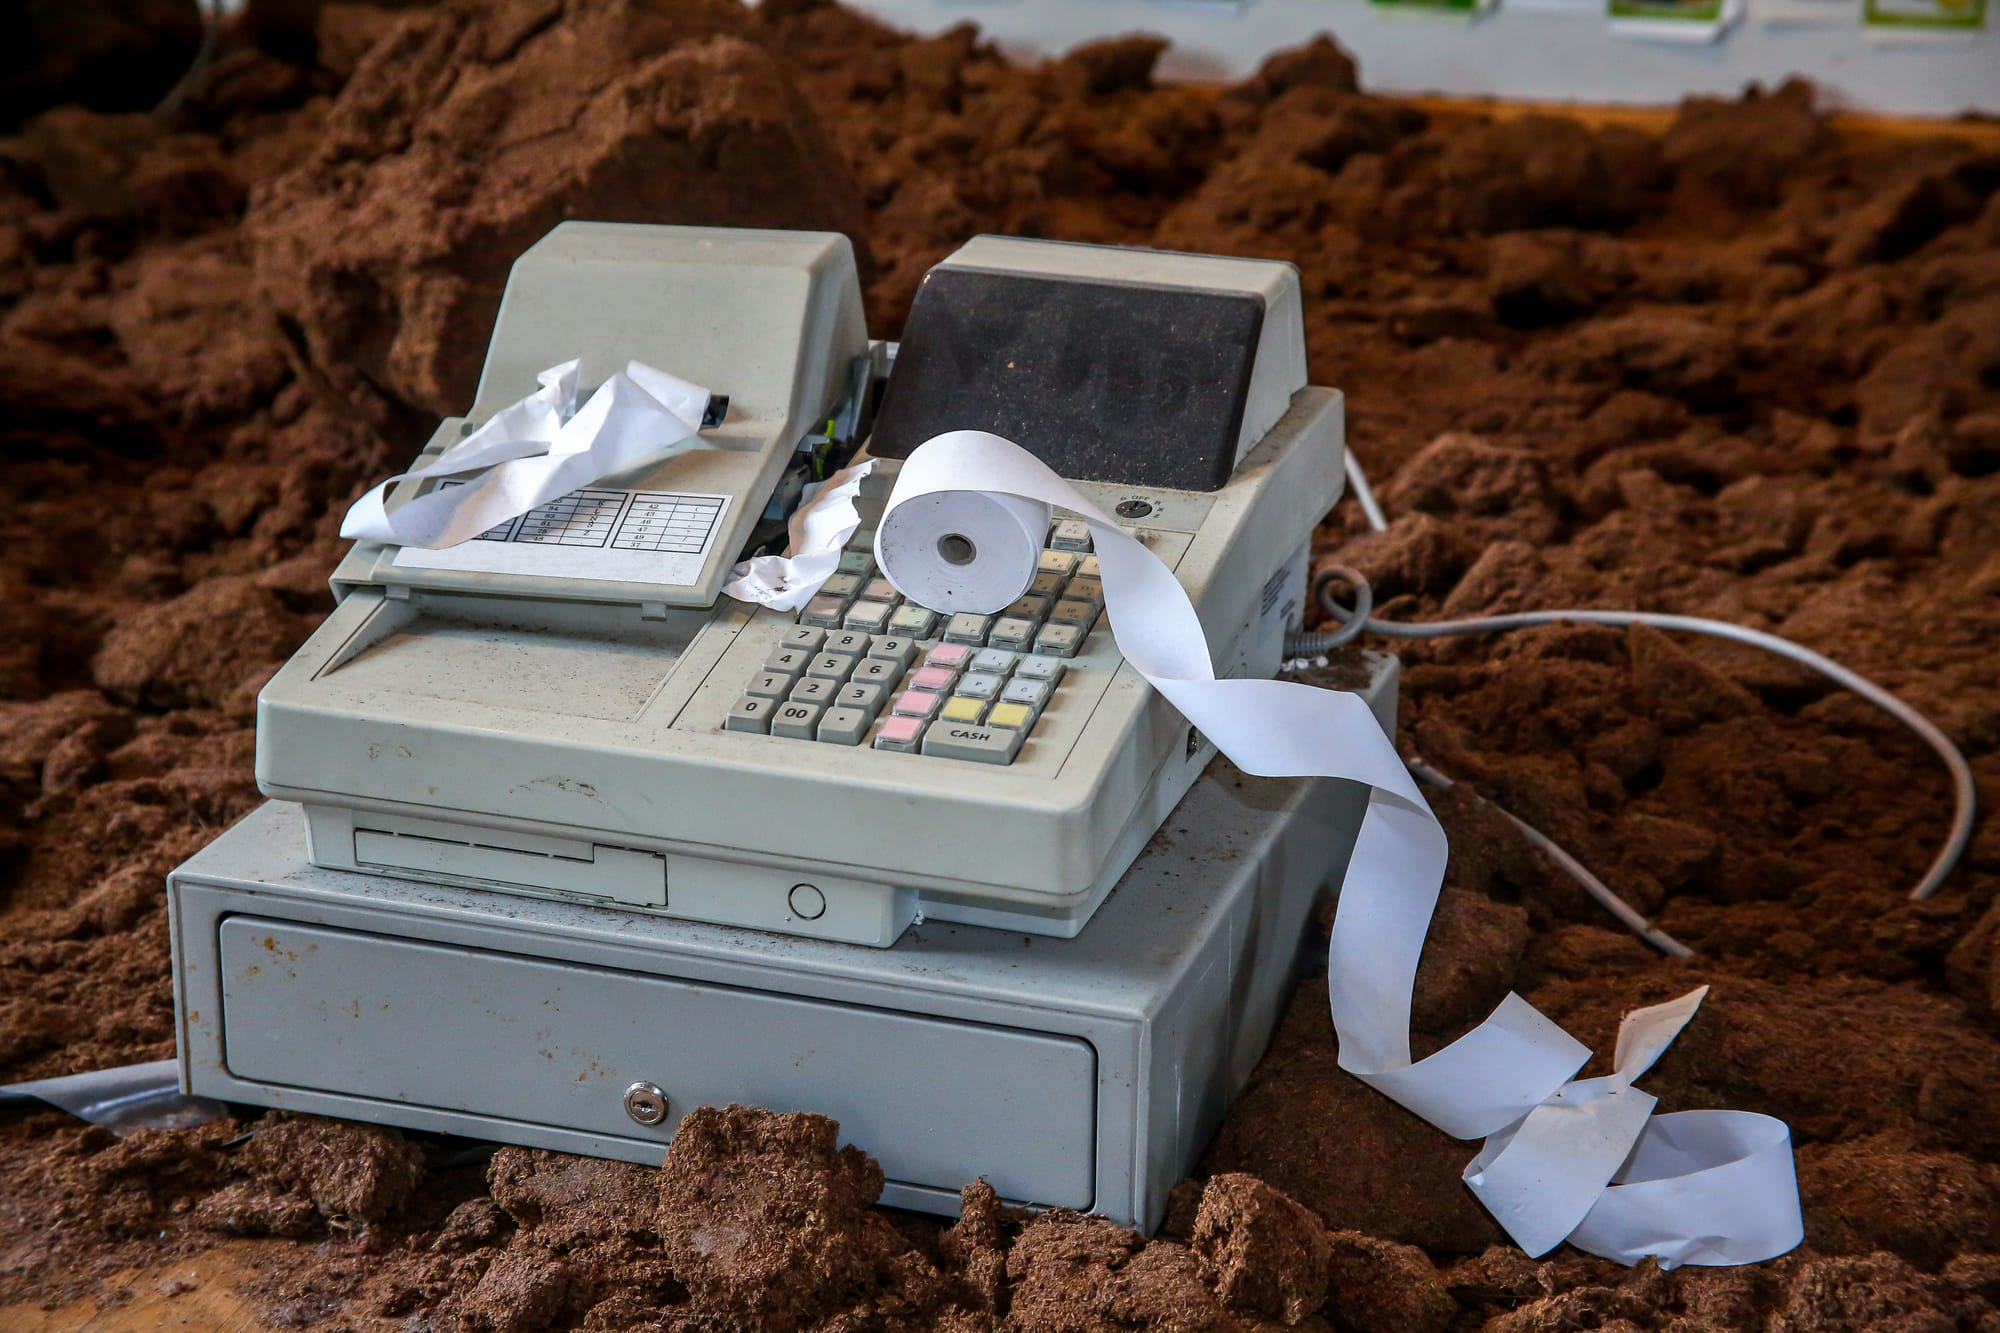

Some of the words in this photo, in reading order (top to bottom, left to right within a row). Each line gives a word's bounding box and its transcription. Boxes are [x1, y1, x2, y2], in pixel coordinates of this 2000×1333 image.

[798, 630, 810, 639] 7
[841, 636, 853, 645] 8
[885, 641, 898, 650] 9
[780, 654, 792, 663] 4
[824, 659, 837, 668] 5
[869, 665, 882, 674] 6
[764, 678, 774, 687] 1
[805, 684, 819, 693] 2
[852, 689, 865, 698] 3
[745, 702, 757, 711] 0
[784, 707, 808, 719] 00
[950, 729, 990, 741] CASH
